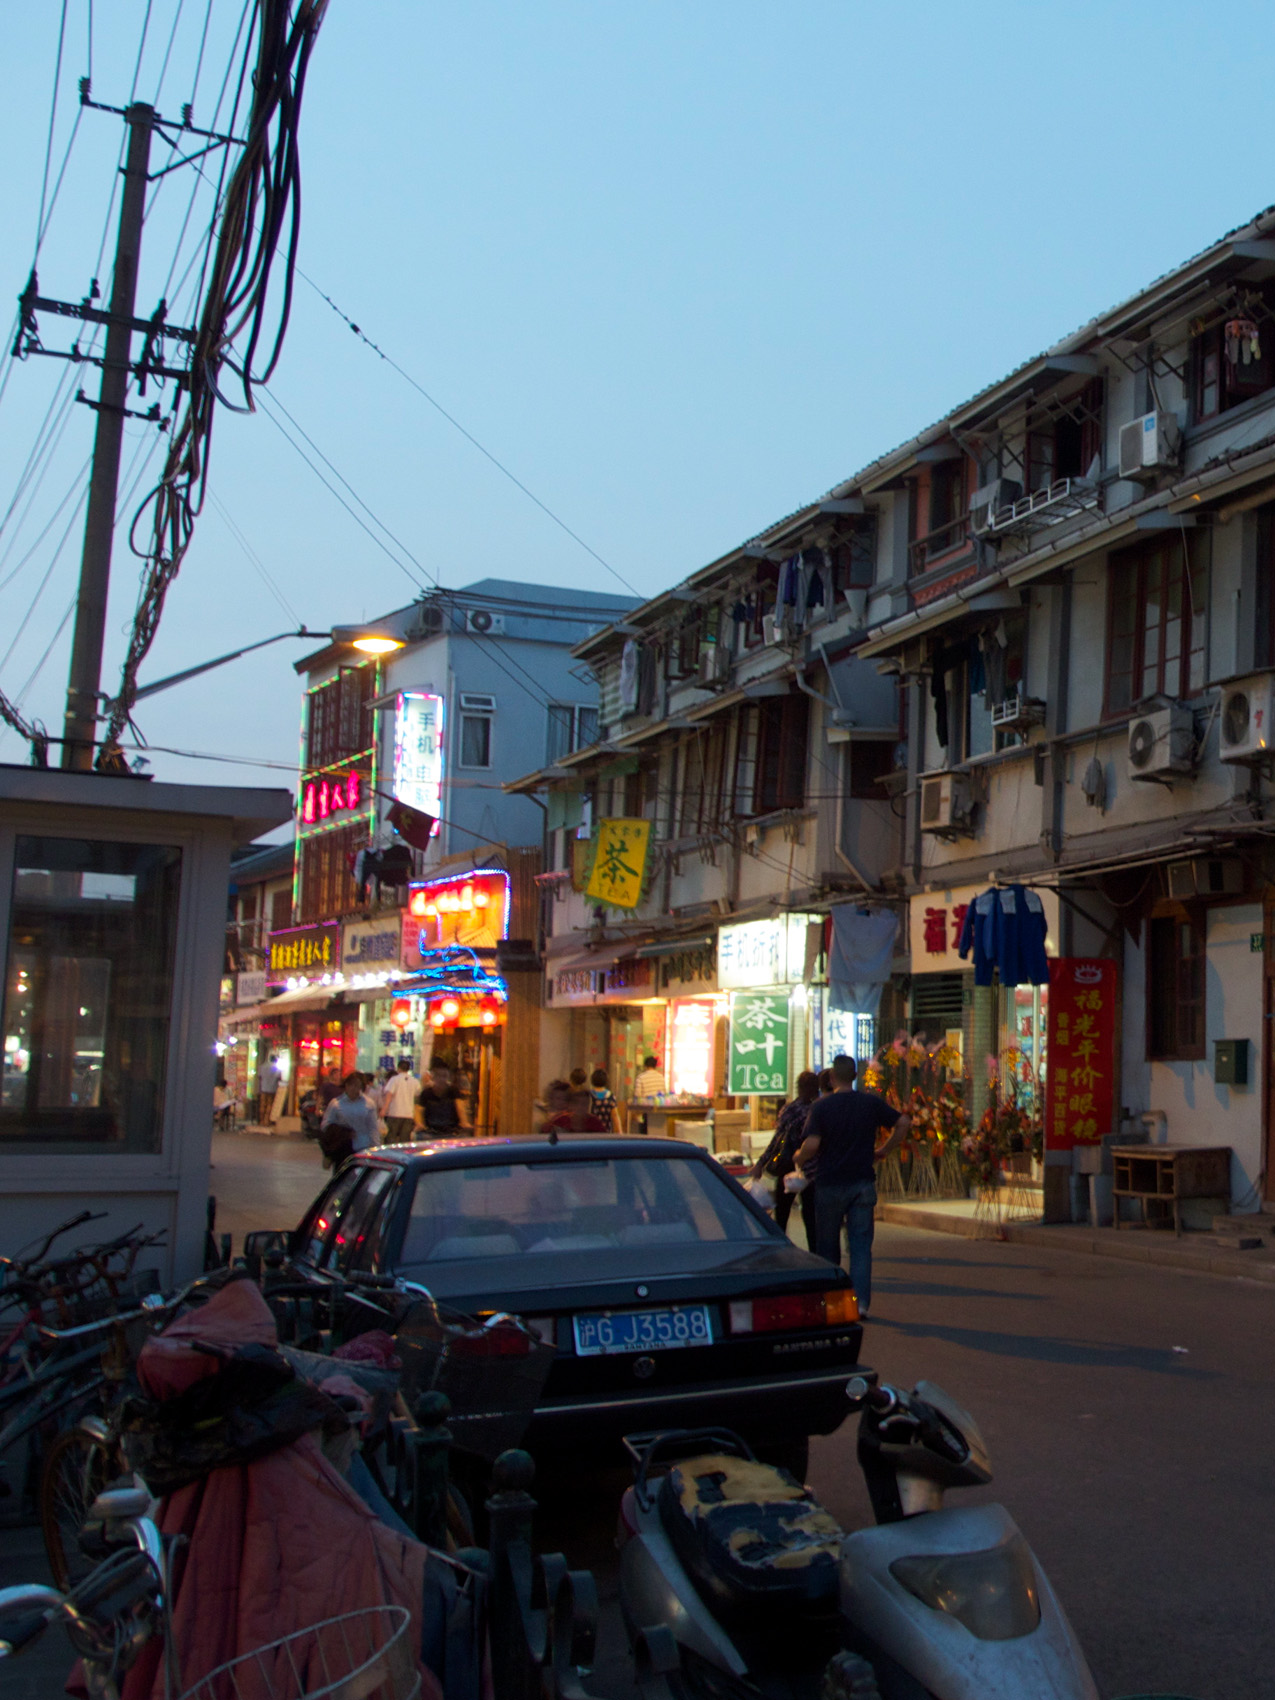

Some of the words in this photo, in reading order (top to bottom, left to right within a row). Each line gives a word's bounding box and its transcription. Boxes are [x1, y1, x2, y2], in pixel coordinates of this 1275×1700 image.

[597, 840, 640, 885] 茶
[380, 1031, 415, 1047] 手机
[735, 997, 787, 1066] 茶叶
[736, 1064, 784, 1089] Tea
[1070, 990, 1104, 1140] 福光平价眼镜
[623, 1311, 707, 1342] J3588
